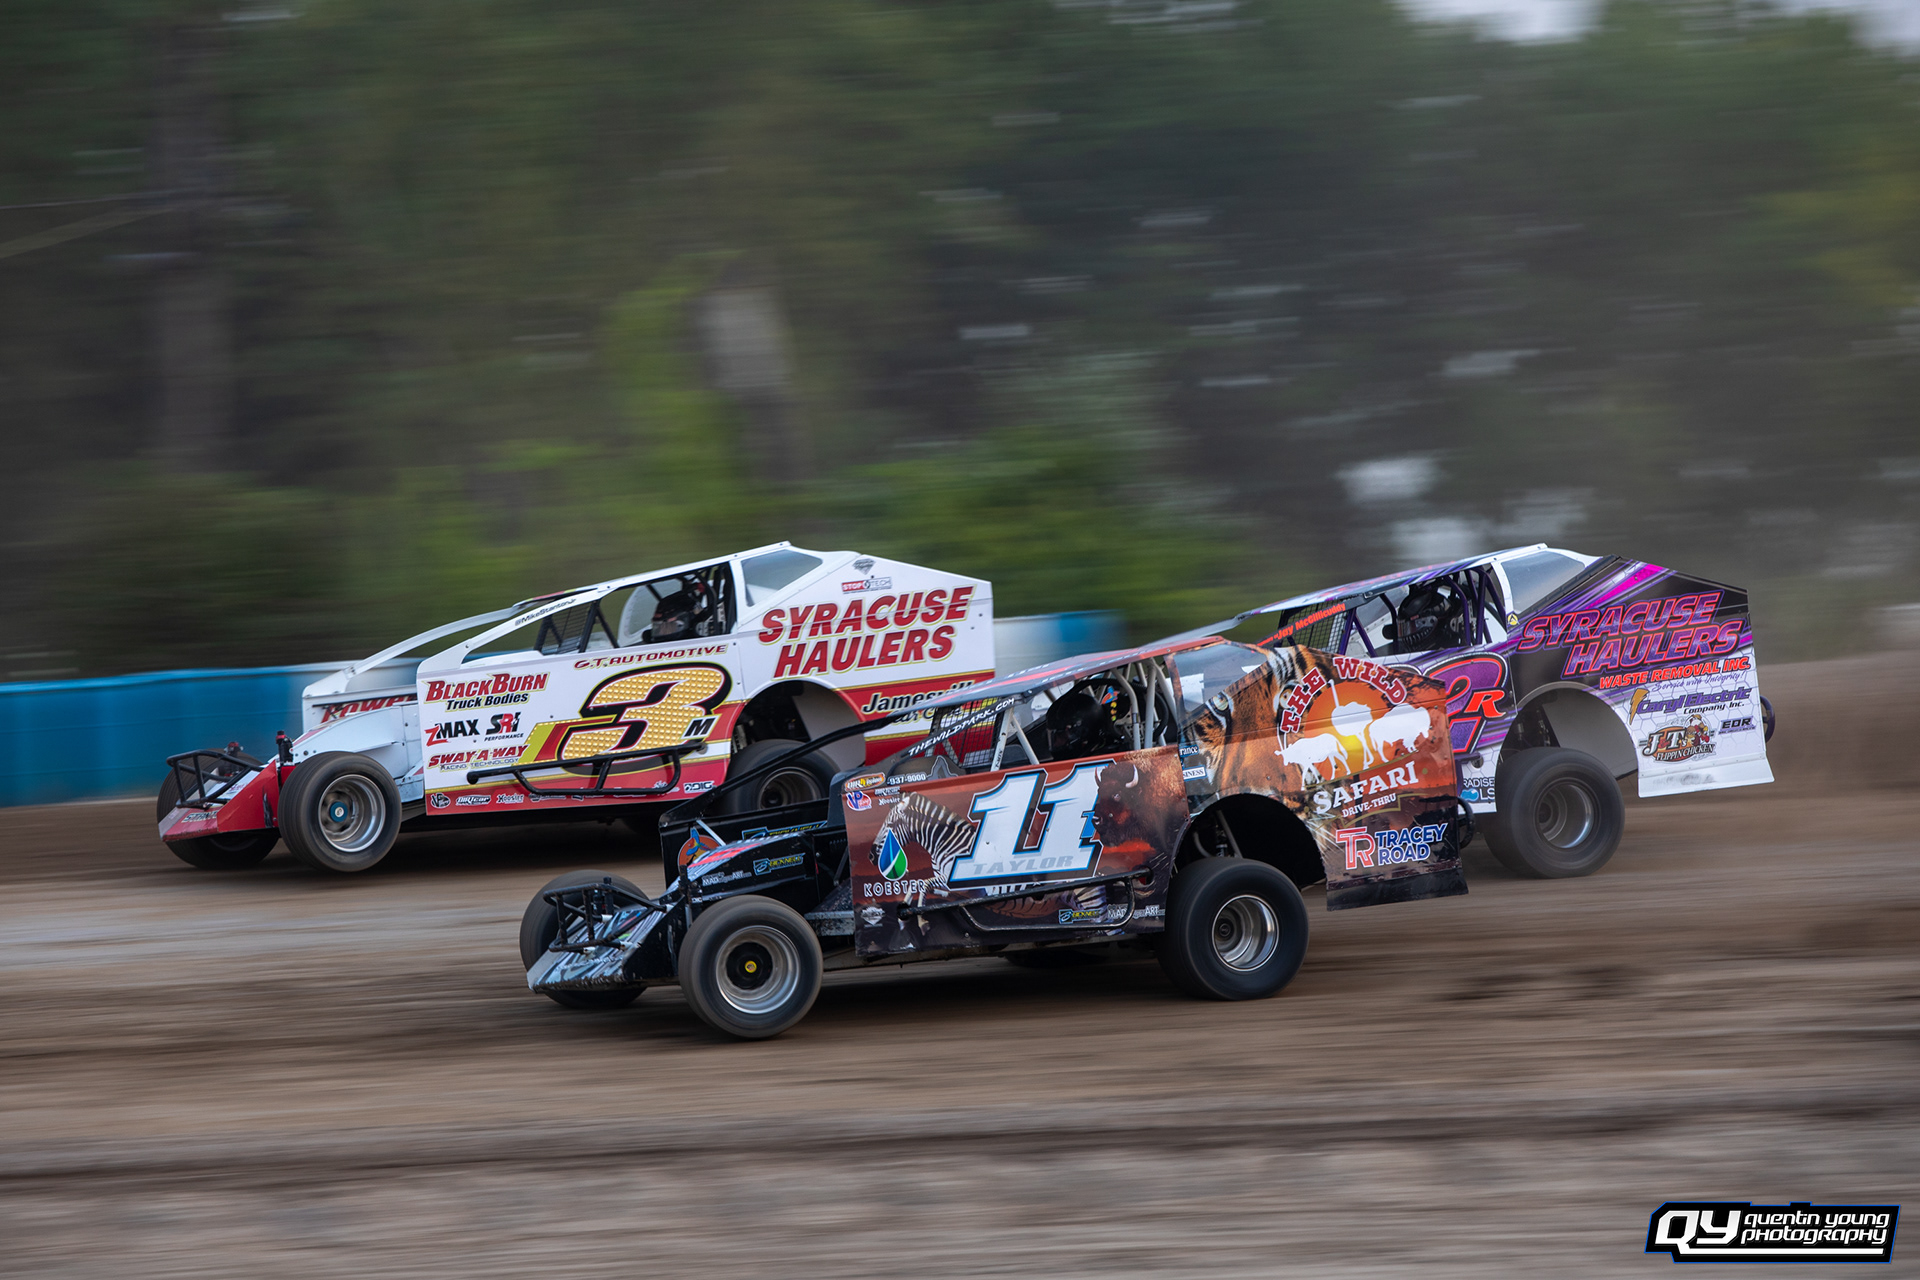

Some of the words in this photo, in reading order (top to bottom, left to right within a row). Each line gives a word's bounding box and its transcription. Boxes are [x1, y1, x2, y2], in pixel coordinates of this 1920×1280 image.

[759, 586, 975, 643] SYRACUSE
[1519, 592, 1721, 650] SYRACUSE
[773, 625, 956, 679] HAULERS
[1563, 620, 1743, 676] HAULERS
[1600, 671, 1648, 689] WASTE
[1651, 664, 1720, 682] REMOVAL
[1723, 657, 1751, 672] INC.
[447, 699, 481, 711] Truck
[484, 693, 528, 706] Bodies
[1280, 667, 1327, 733] THE
[1333, 657, 1407, 704] WILD
[1684, 688, 1752, 707] Electric
[1684, 705, 1725, 715] Company
[484, 733, 524, 742] PERFORMANCE
[684, 717, 717, 738] M
[908, 698, 1015, 756] THEWILDPARK.COM
[470, 758, 519, 768] TECHNOLOGY
[1313, 761, 1419, 815] SAFARI
[1341, 793, 1397, 817] DRIVE-THRU
[1375, 823, 1448, 848] TRACEY
[974, 855, 1074, 875] TAYLOR
[1377, 844, 1430, 867] ROAD
[863, 879, 927, 898] KOESTER
